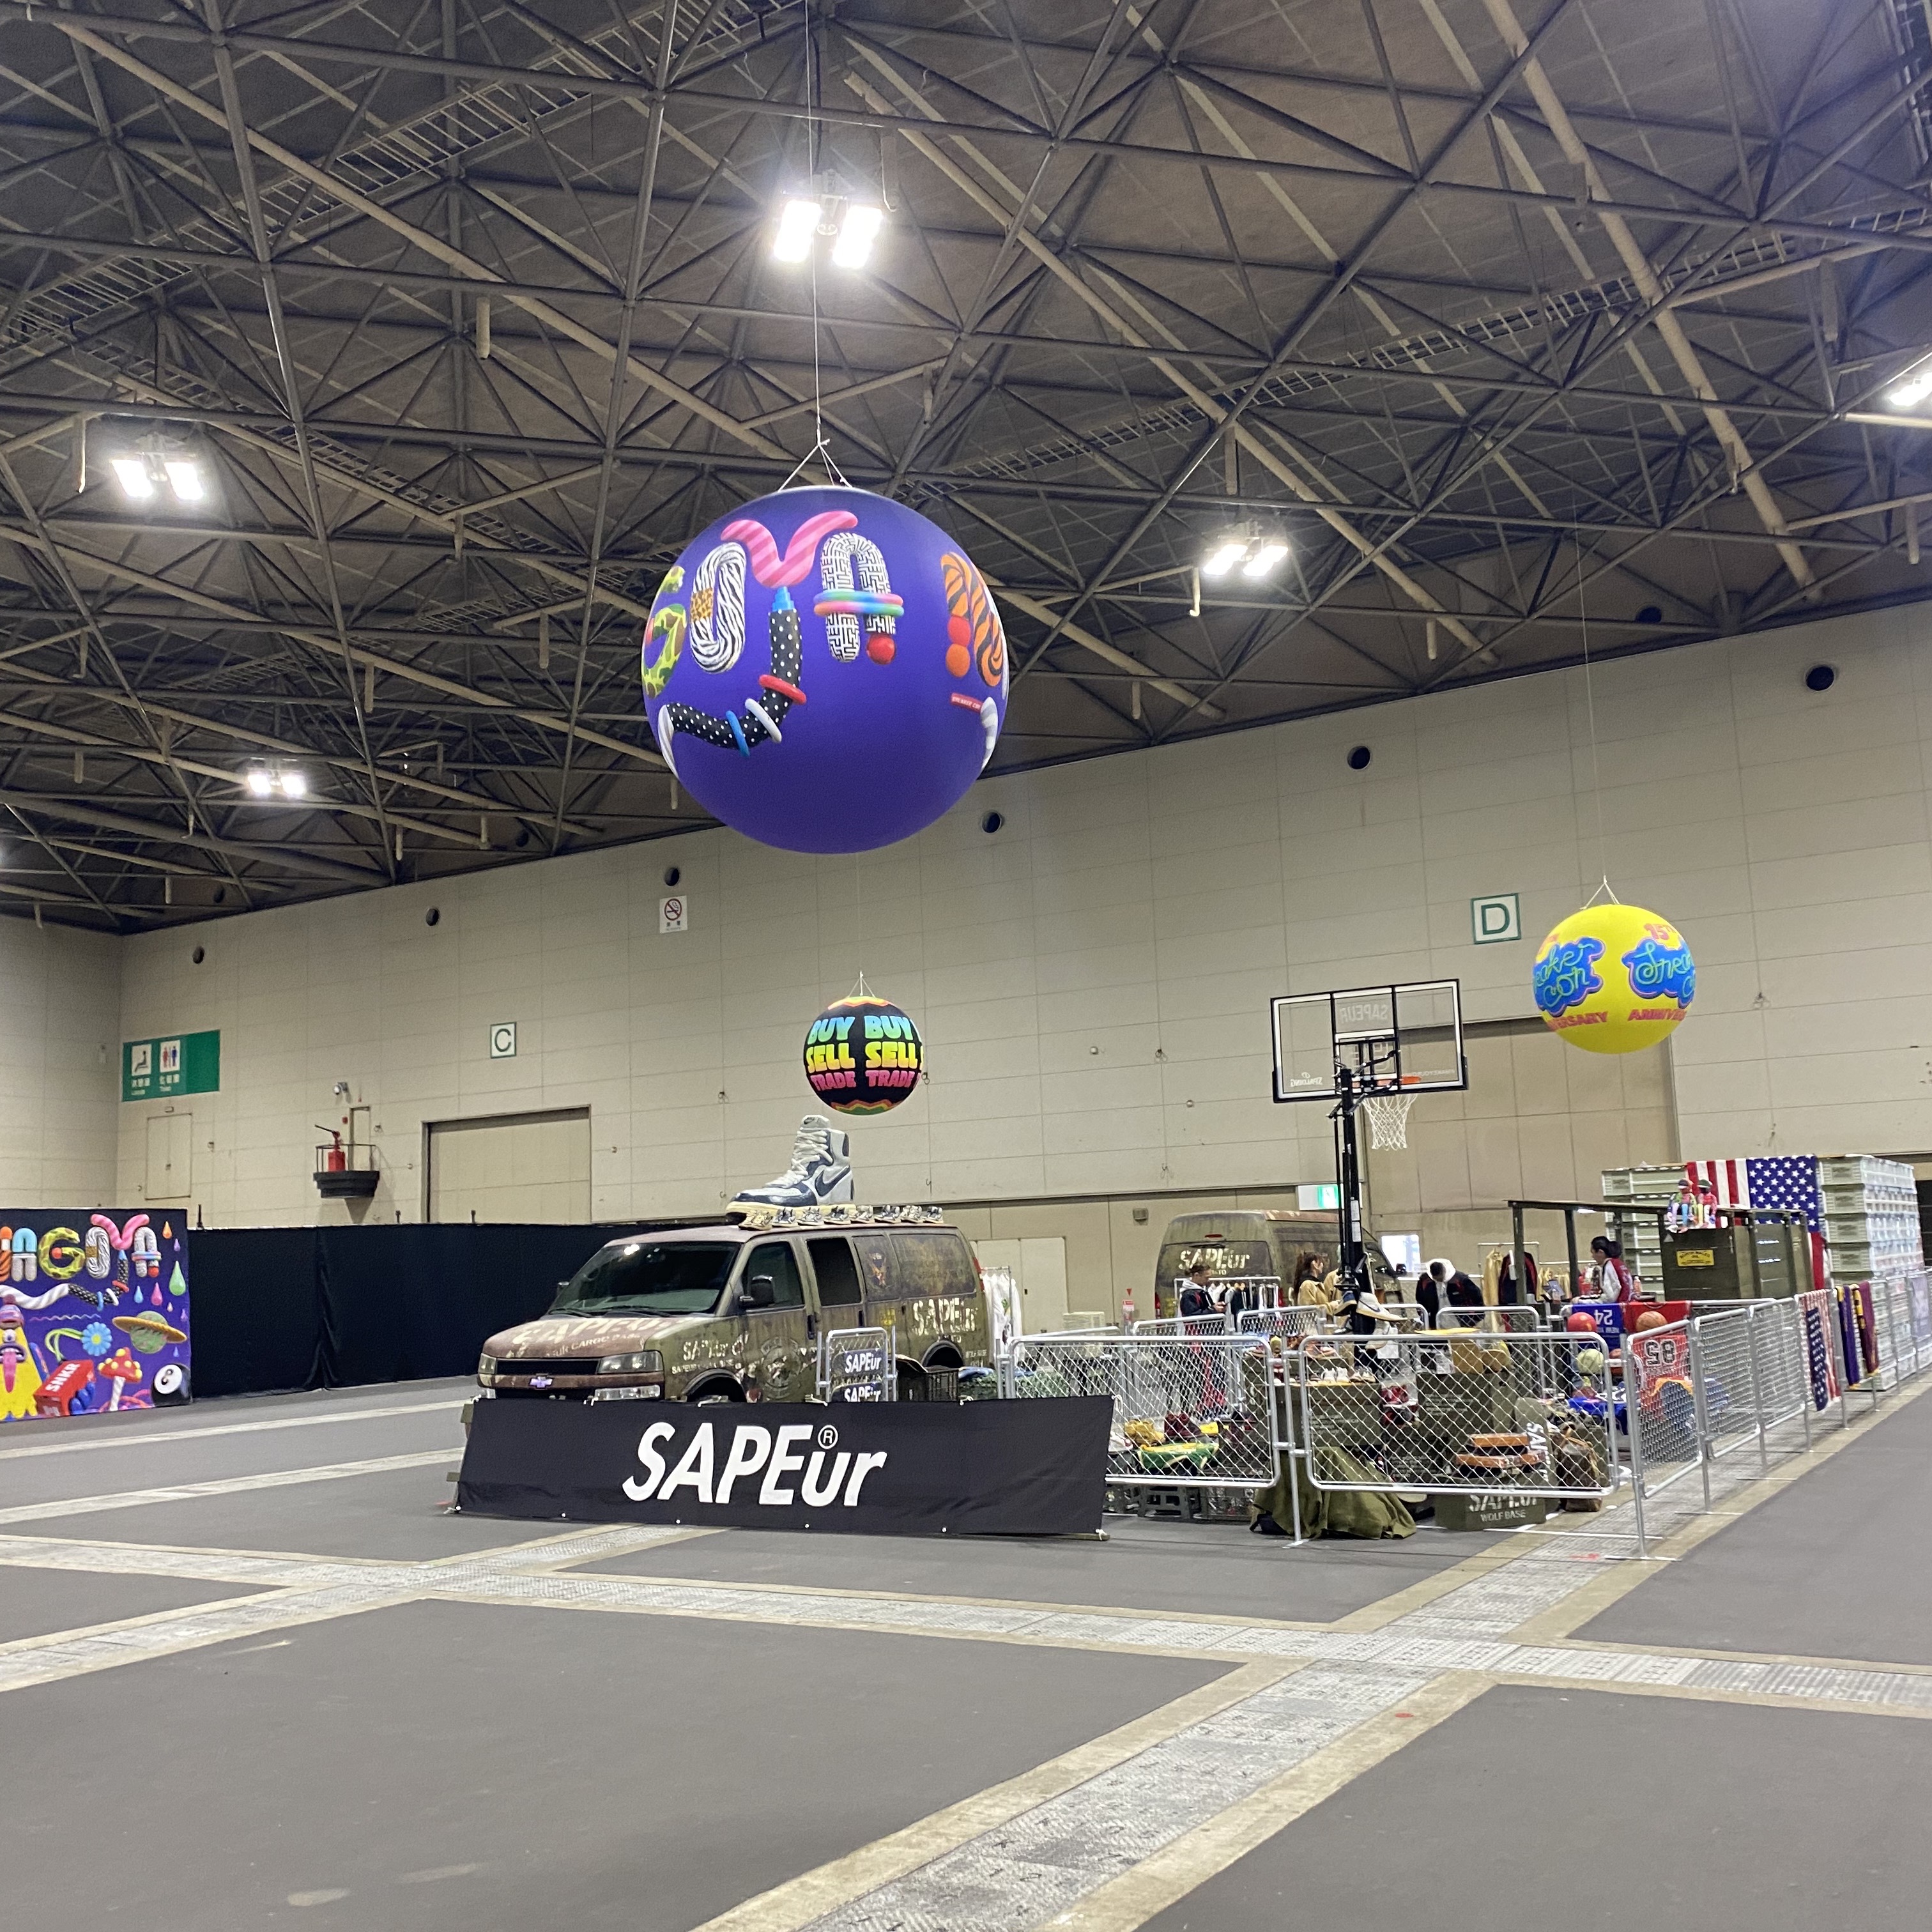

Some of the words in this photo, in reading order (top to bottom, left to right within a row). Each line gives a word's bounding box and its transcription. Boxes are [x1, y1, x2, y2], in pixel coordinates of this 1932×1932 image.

[1481, 903, 1510, 935] D
[495, 1028, 512, 1053] C
[864, 1016, 914, 1041] BUY
[806, 1043, 855, 1074] SELL
[865, 1041, 918, 1069] SELL
[810, 1071, 857, 1091] TRADE
[865, 1070, 916, 1089] TRADE
[0, 1214, 162, 1281] AGOYA
[1593, 1309, 1613, 1326] 24
[845, 1351, 882, 1374] SAPEur
[45, 1363, 80, 1392] SNKR
[1480, 1511, 1503, 1522] WOLF
[1504, 1508, 1527, 1520] BASE
